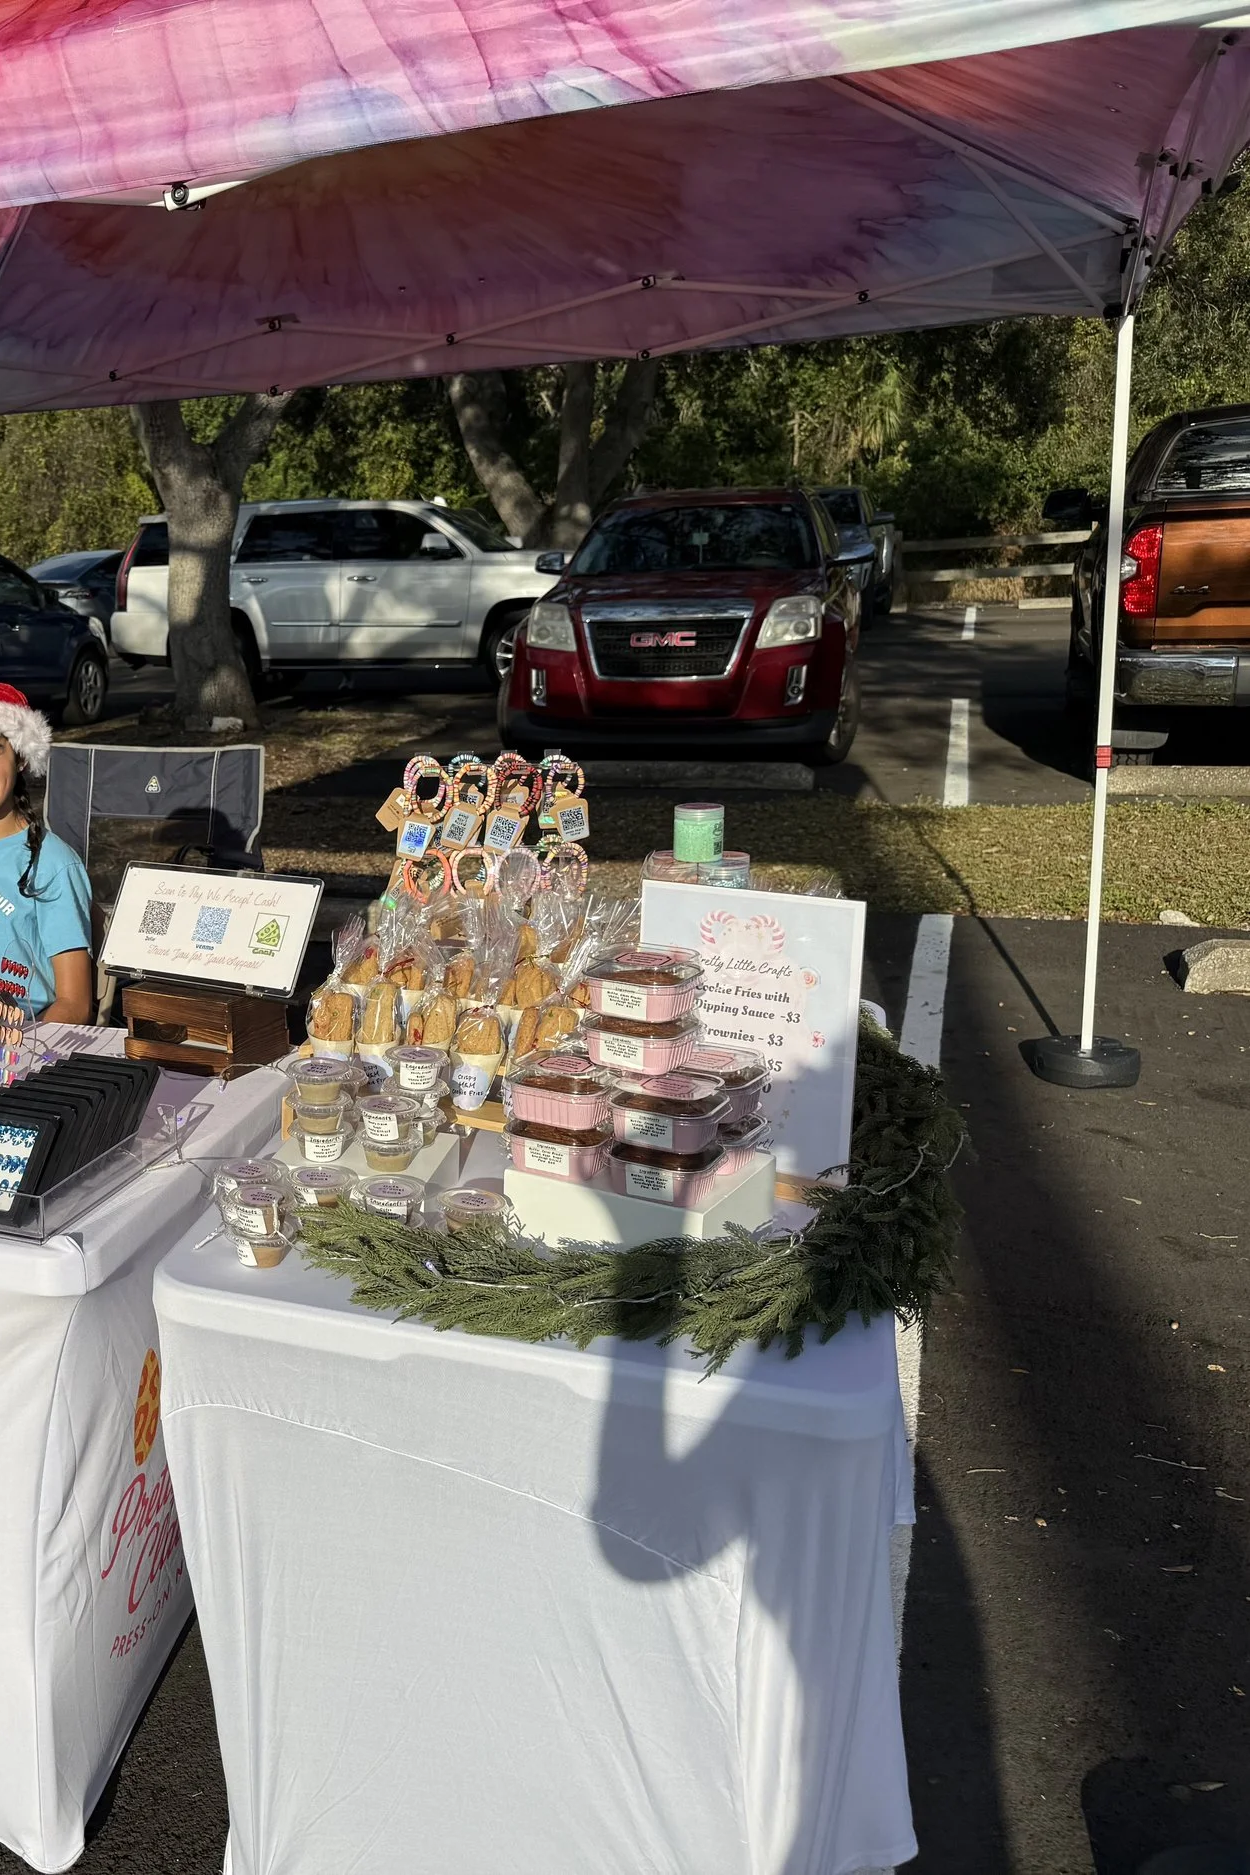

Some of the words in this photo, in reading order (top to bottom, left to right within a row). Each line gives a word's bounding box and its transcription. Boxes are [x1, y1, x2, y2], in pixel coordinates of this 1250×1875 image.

[630, 631, 696, 647] GMC
[155, 881, 175, 895] Scan
[178, 884, 186, 897] to
[189, 886, 203, 904] Pay
[207, 887, 220, 901] We
[223, 889, 253, 908] Accept
[254, 892, 281, 907] Cash!
[147, 944, 169, 957] Thank
[171, 948, 188, 960] You
[189, 950, 202, 965] for
[204, 953, 225, 966] Your
[226, 957, 264, 970] Support!
[252, 947, 275, 957] Cash
[700, 955, 724, 972] retty
[726, 958, 757, 972] Little
[759, 962, 793, 979] Crafts
[734, 985, 762, 999] Fries
[765, 991, 790, 1003] with
[741, 1006, 775, 1020] Sauce
[767, 1033, 784, 1047] $3
[768, 1058, 782, 1073] $5
[458, 1074, 476, 1082] Crispy
[101, 1465, 174, 1579] Prett
[110, 1591, 170, 1660] PRESS-ON
